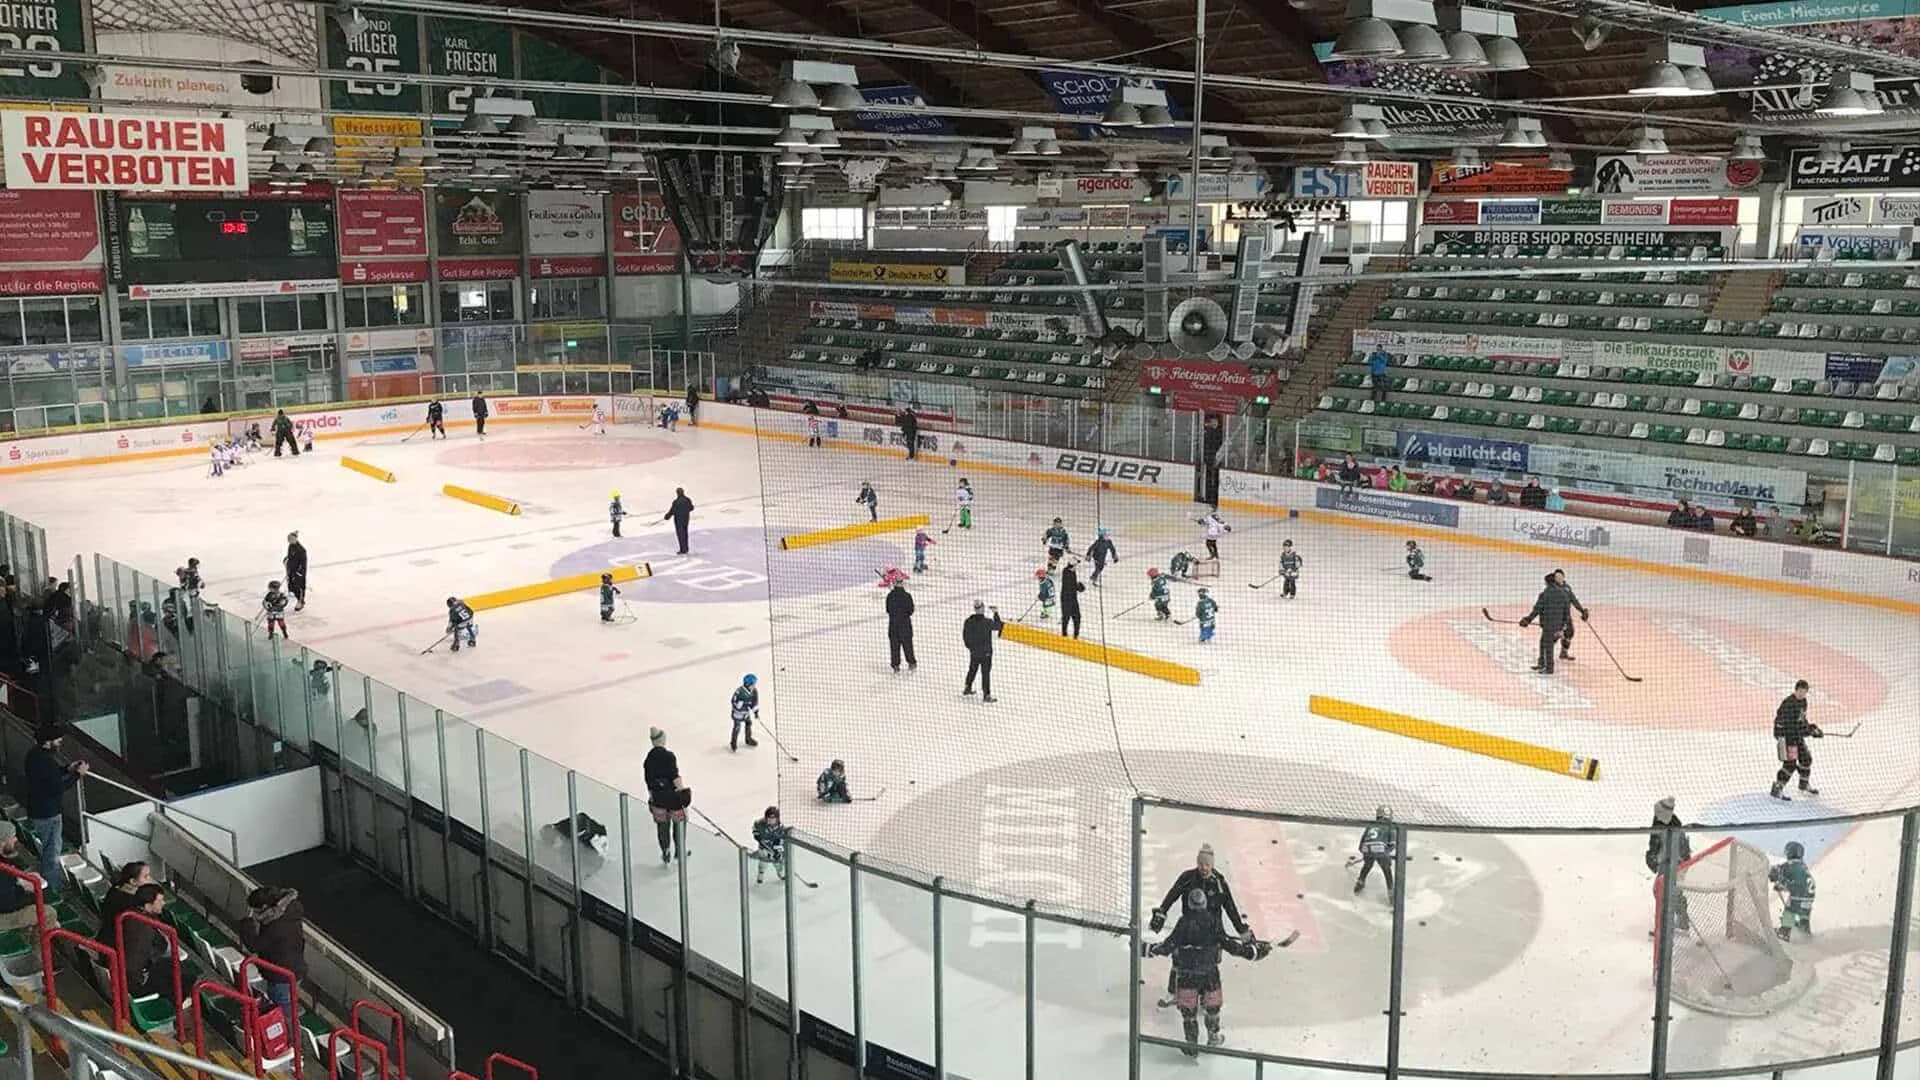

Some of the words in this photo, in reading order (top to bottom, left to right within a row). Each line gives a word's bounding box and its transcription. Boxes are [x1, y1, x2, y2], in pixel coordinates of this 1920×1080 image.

[349, 33, 398, 55] HILGER
[445, 37, 470, 49] KARL
[446, 51, 498, 73] FRIESEN
[114, 73, 172, 88] Zukunft
[346, 56, 402, 96] 25
[25, 116, 225, 152] RAUCHEN
[22, 153, 235, 186] VERBOTEN
[1367, 162, 1413, 179] RAUCHEN
[1798, 154, 1900, 175] CRAFT
[1366, 181, 1415, 195] VERBOTEN
[1812, 197, 1862, 223] Tati's
[1474, 231, 1528, 244] BARBER
[1532, 231, 1570, 244] SHOP
[1574, 231, 1664, 245] ROSENHEIM
[14, 281, 32, 292] für
[34, 280, 52, 291] die
[55, 278, 99, 294] Region.
[370, 270, 415, 281] Sparkasse
[1603, 343, 1622, 353] Die
[1648, 356, 1717, 371] Rosenheim
[1427, 441, 1522, 463] blaulicht.de
[1055, 453, 1162, 483] BAUER
[1664, 473, 1775, 500] TechnoMarkt
